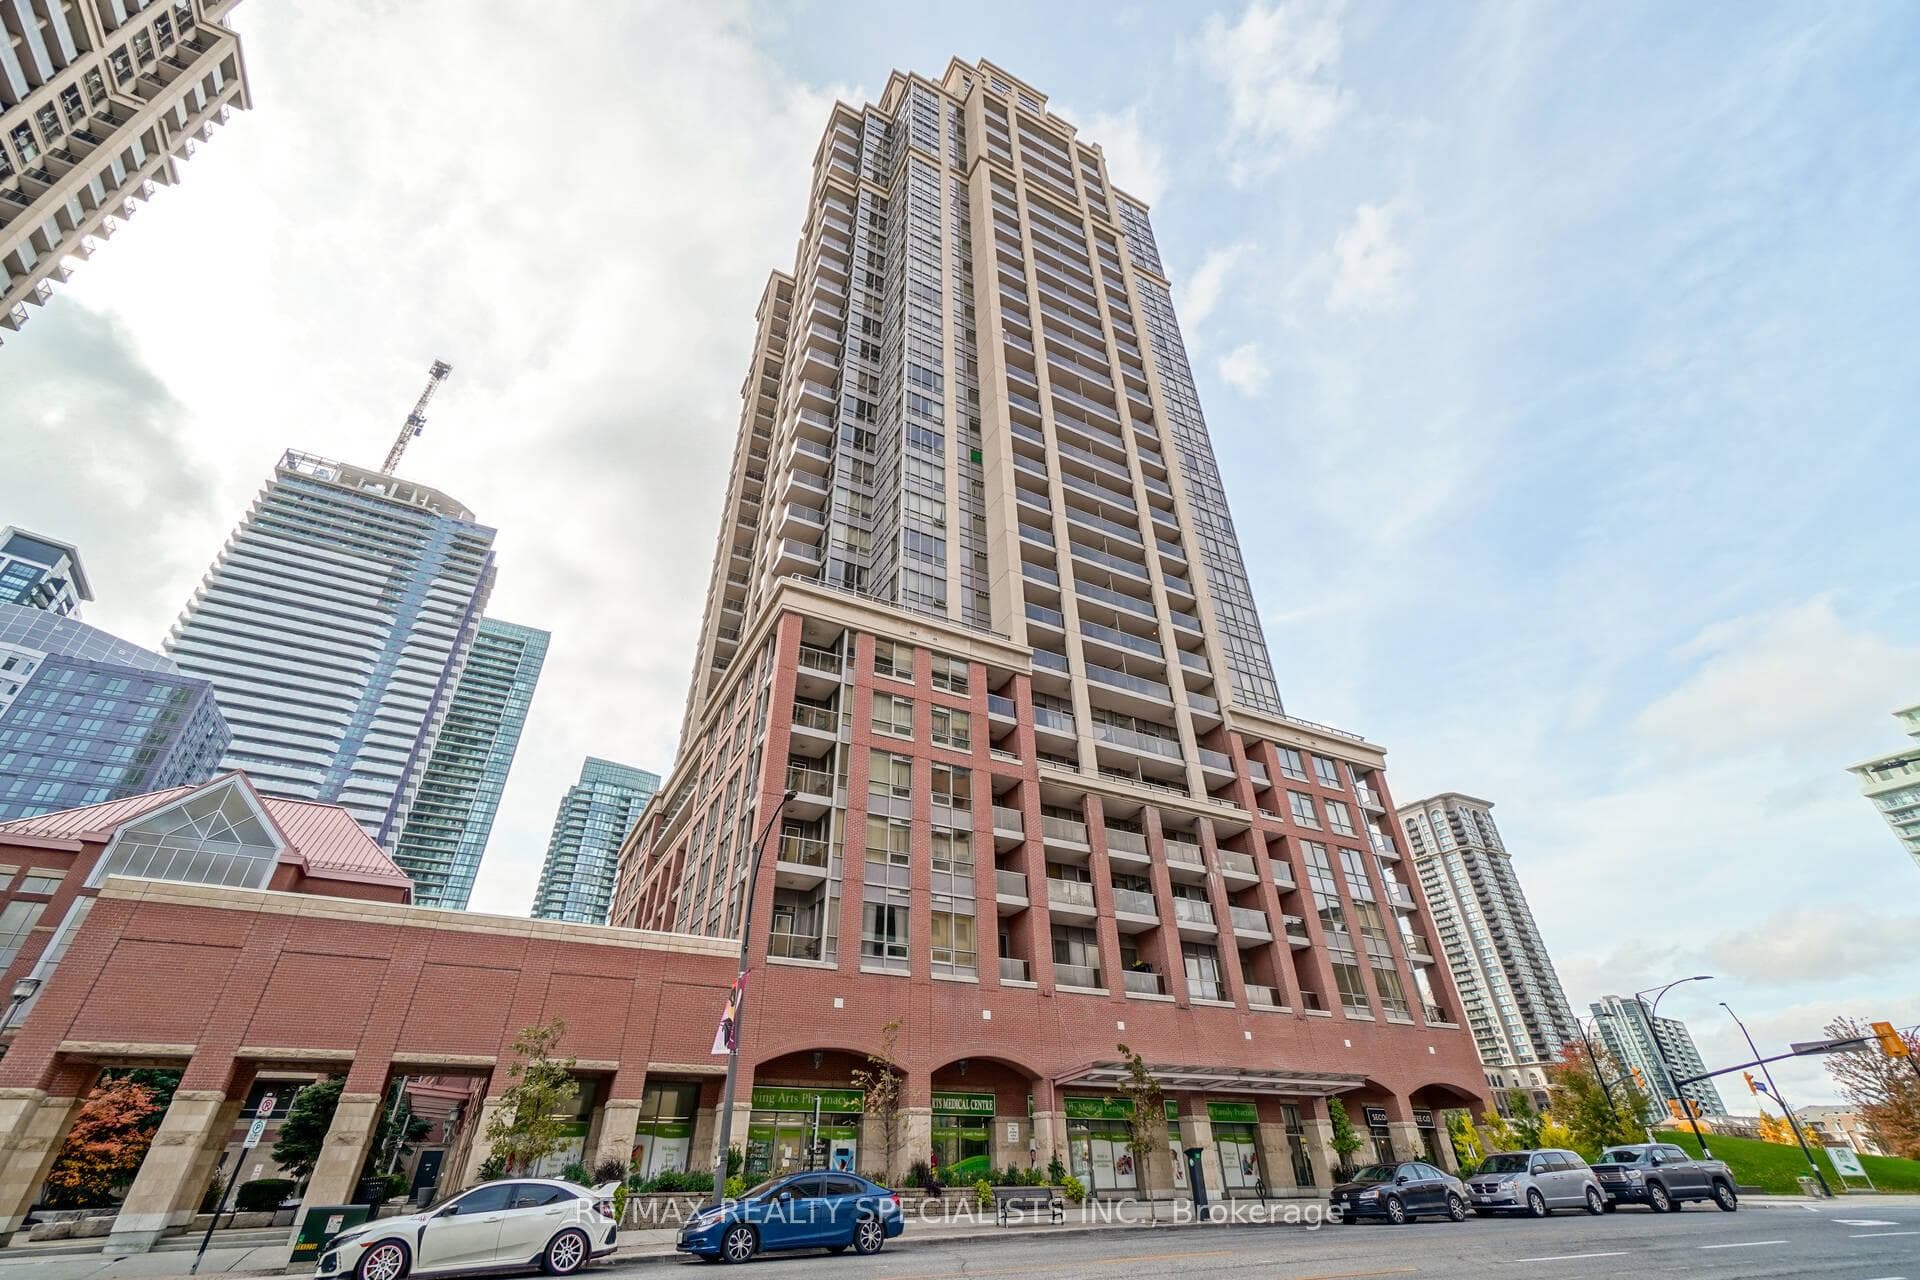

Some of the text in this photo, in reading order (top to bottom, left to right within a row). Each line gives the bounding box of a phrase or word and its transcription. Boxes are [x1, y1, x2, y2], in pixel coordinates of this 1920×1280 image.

[778, 1092, 799, 1104] Arts
[801, 1093, 850, 1107] Phrmacy
[943, 1098, 970, 1110] MEDICAL
[970, 1099, 994, 1111] CENTRE
